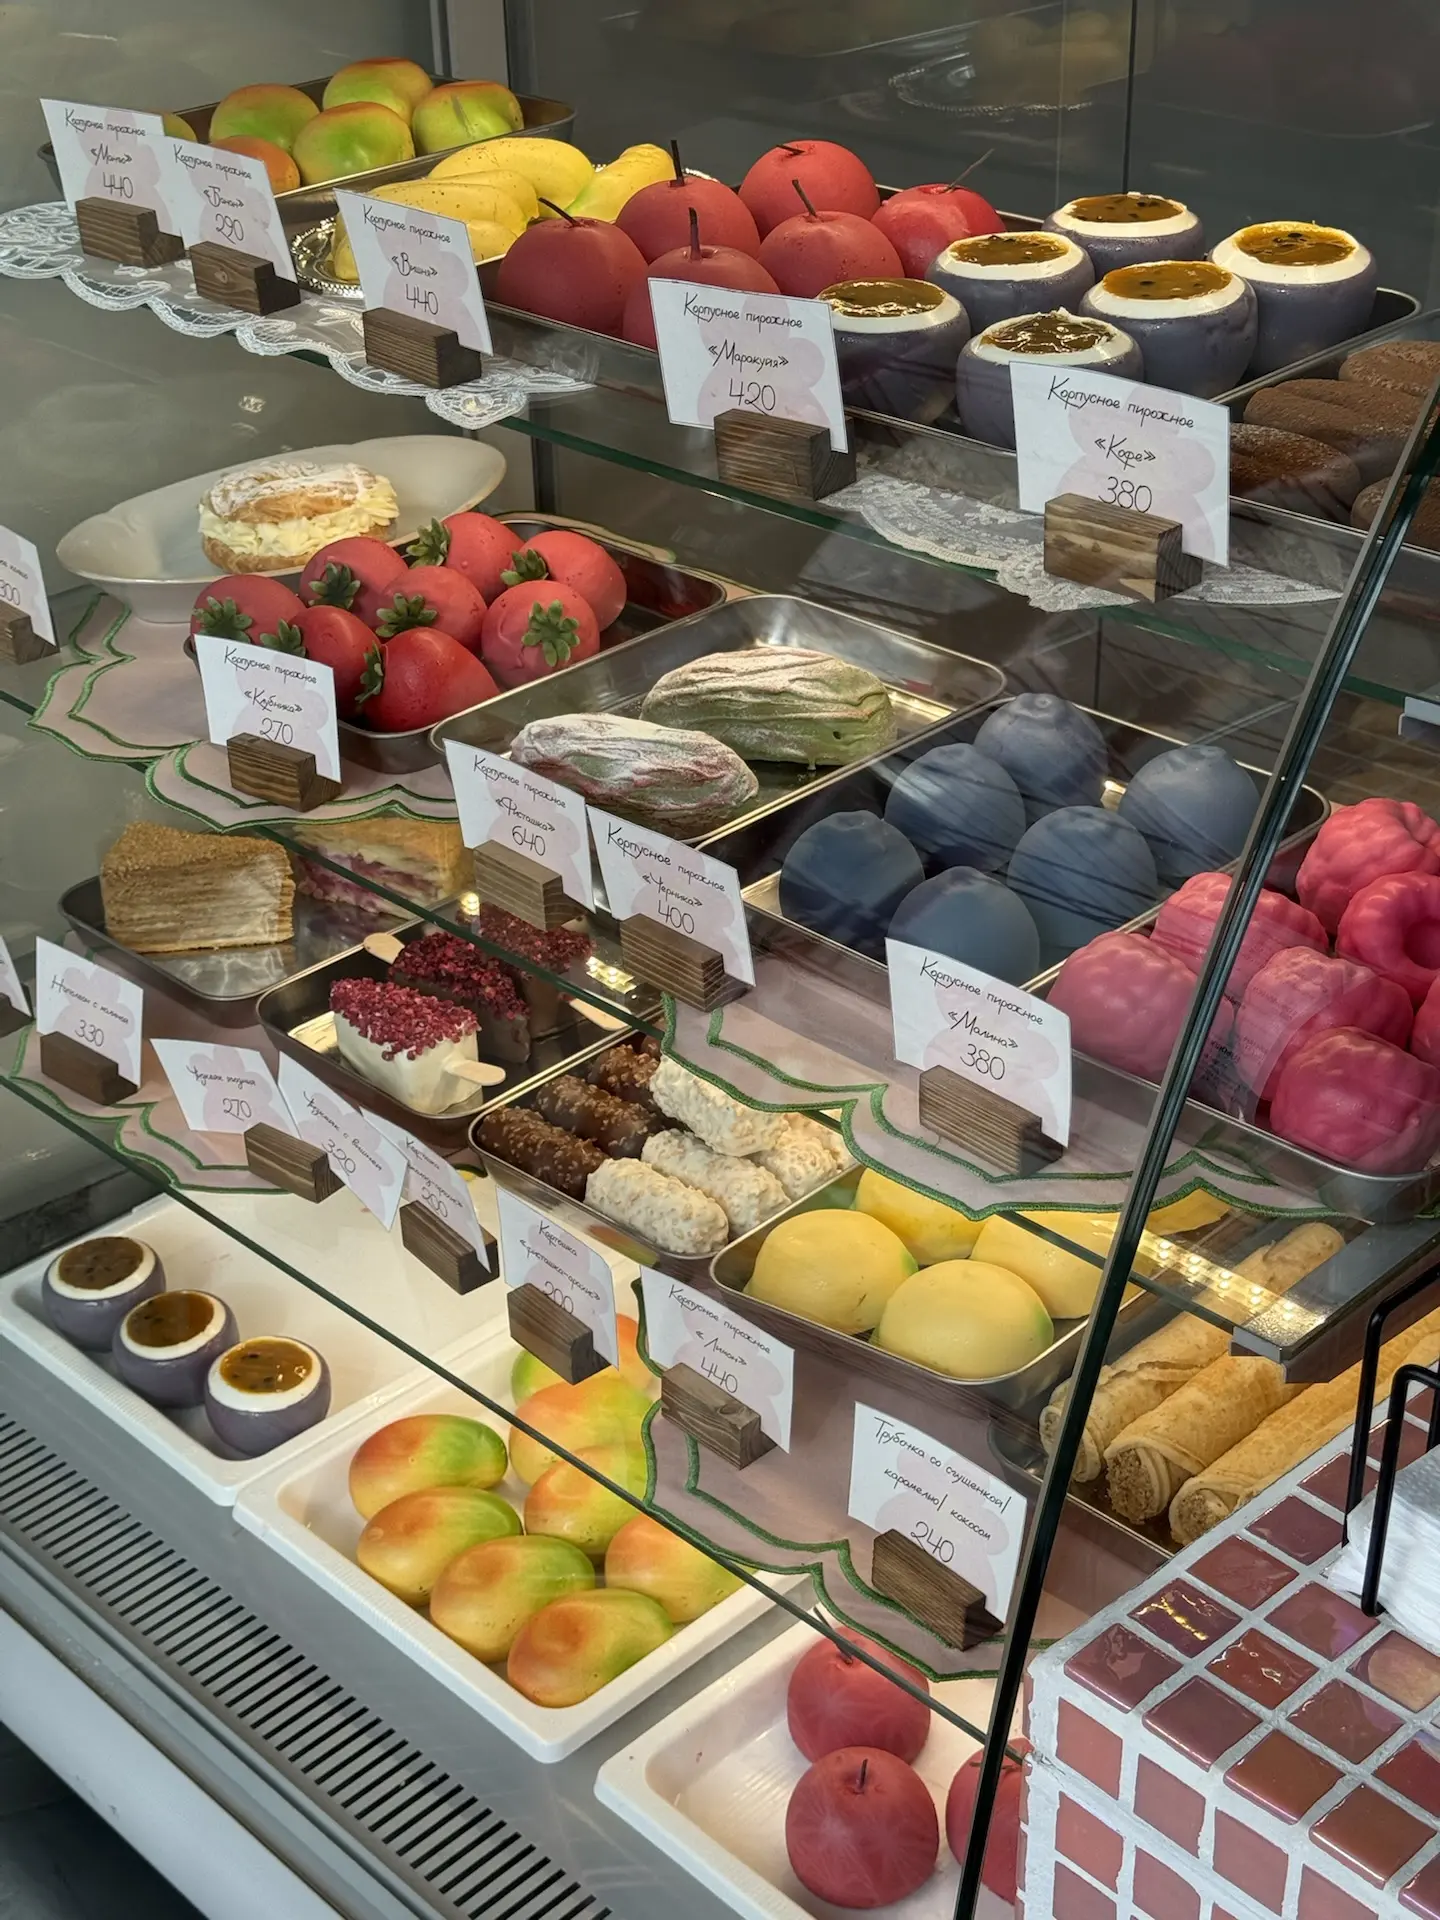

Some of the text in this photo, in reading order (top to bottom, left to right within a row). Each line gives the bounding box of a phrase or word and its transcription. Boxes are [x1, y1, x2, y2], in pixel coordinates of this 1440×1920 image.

[103, 172, 133, 199] 440
[215, 213, 244, 245] 290
[405, 284, 439, 315] 440
[684, 292, 803, 333] Корпусное пирожное
[708, 339, 789, 373] «Маракуйя»
[729, 378, 776, 416] 420
[1048, 375, 1194, 427] Корпусное пирожное
[1094, 434, 1156, 471] «Кофе»
[1098, 476, 1153, 513] 380
[260, 717, 294, 744] 270
[473, 754, 566, 808] Корпусное пирожное
[512, 825, 546, 856] 640
[607, 821, 726, 892] Корпусное пирожное
[658, 900, 695, 934] 400
[919, 956, 1044, 1025] Корпусное пирожное
[75, 1019, 104, 1047] 330
[948, 1010, 1018, 1049] «Малина»
[960, 1043, 1006, 1080] 380
[223, 1097, 251, 1122] 270
[321, 1139, 356, 1177] 320
[700, 1356, 738, 1394] 440
[874, 1417, 925, 1458] Трубочка
[910, 1521, 955, 1563] 240
[950, 1509, 992, 1541] кокосом
